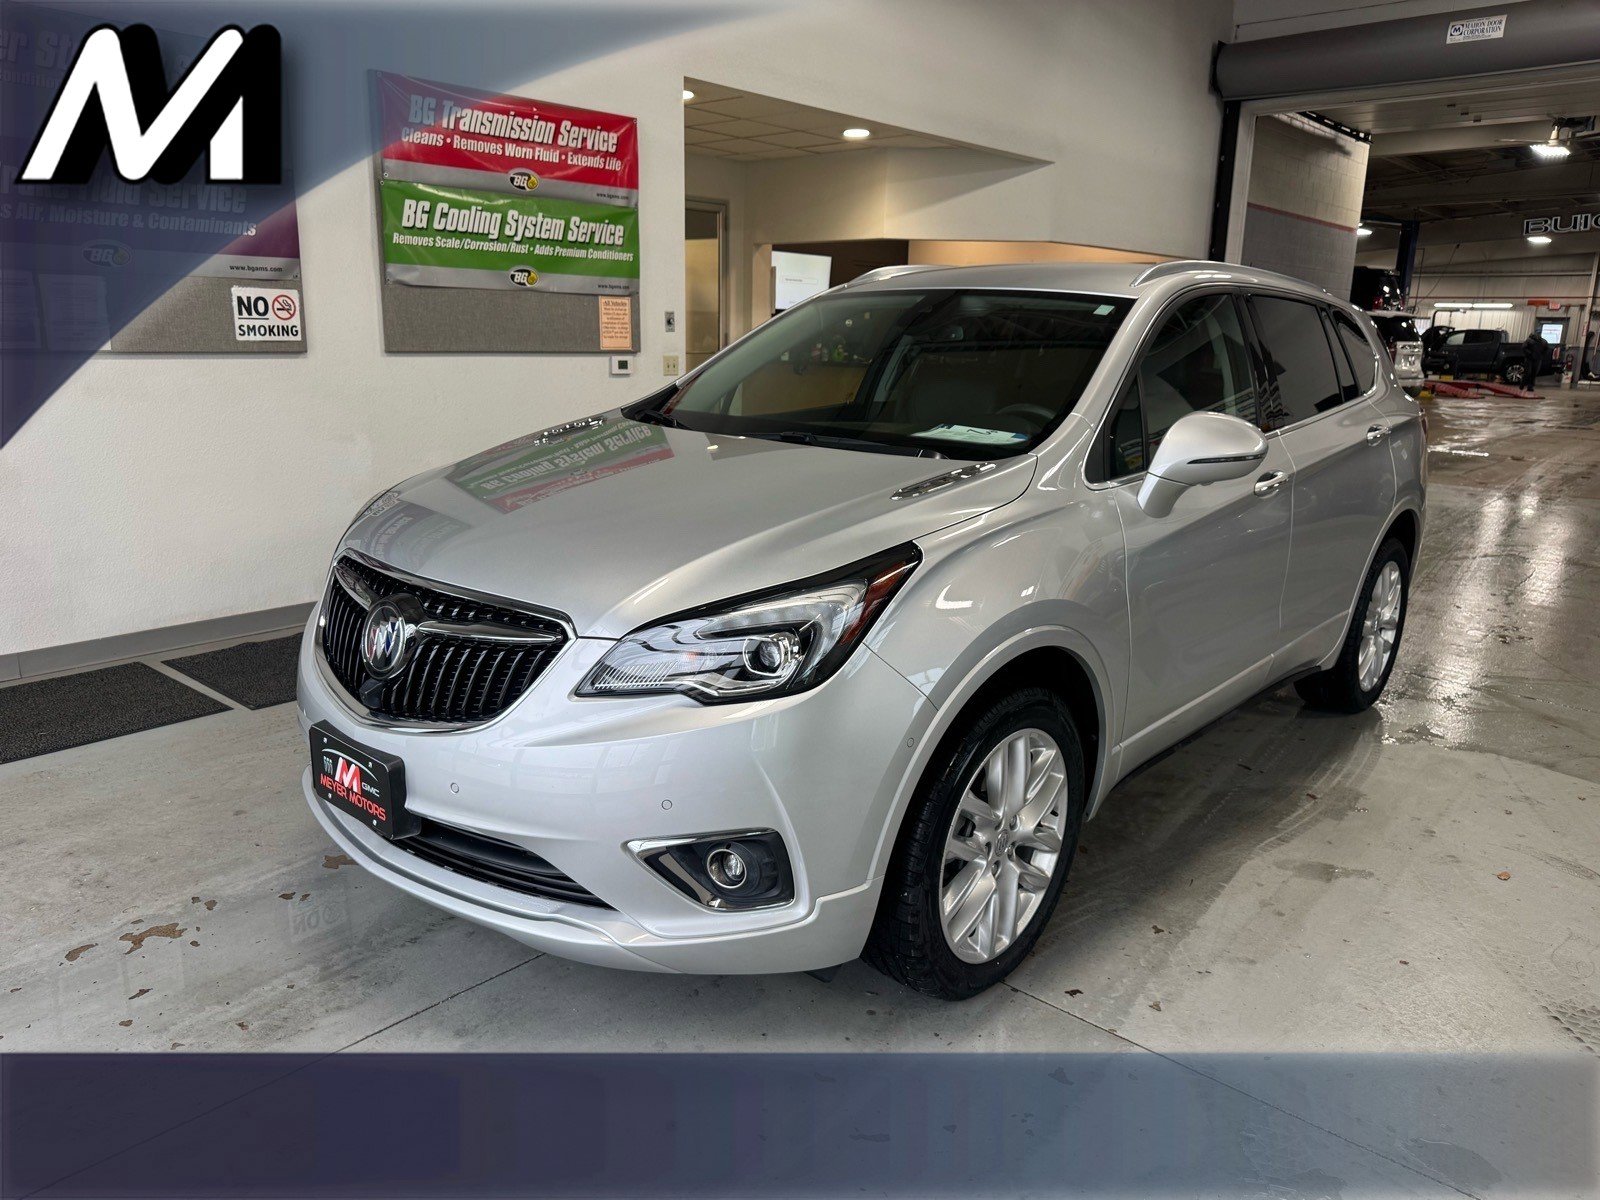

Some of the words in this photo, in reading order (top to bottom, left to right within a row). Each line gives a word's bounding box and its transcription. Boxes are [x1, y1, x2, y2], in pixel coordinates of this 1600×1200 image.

[1463, 26, 1502, 36] CORPORATION
[408, 94, 437, 126] BG
[442, 100, 556, 145] Transmission
[557, 120, 619, 153] Service
[401, 127, 445, 147] Cleans
[453, 135, 503, 156] Removes
[505, 142, 533, 160] Worn
[535, 147, 560, 163] Fluid
[567, 152, 604, 169] Extends
[605, 157, 622, 171] Life
[512, 174, 528, 187] BG
[49, 204, 130, 227] Moisture
[148, 213, 258, 236] Contaminants
[402, 198, 431, 229] BG
[433, 202, 503, 240] Cooling
[504, 209, 566, 242] System
[567, 216, 625, 246] Service
[392, 232, 434, 247] Removes
[435, 236, 529, 254] Scale/Corrosion/Rust
[534, 244, 553, 256] Adds
[554, 246, 587, 259] Premium
[588, 248, 634, 262] Conditioners
[229, 265, 283, 273] www.bgams.com
[512, 271, 528, 283] BG
[236, 295, 270, 317] NO
[238, 324, 299, 337] SMOKING
[320, 773, 348, 799] MEYER
[349, 791, 387, 821] MOTORS
[362, 782, 380, 798] GMC
